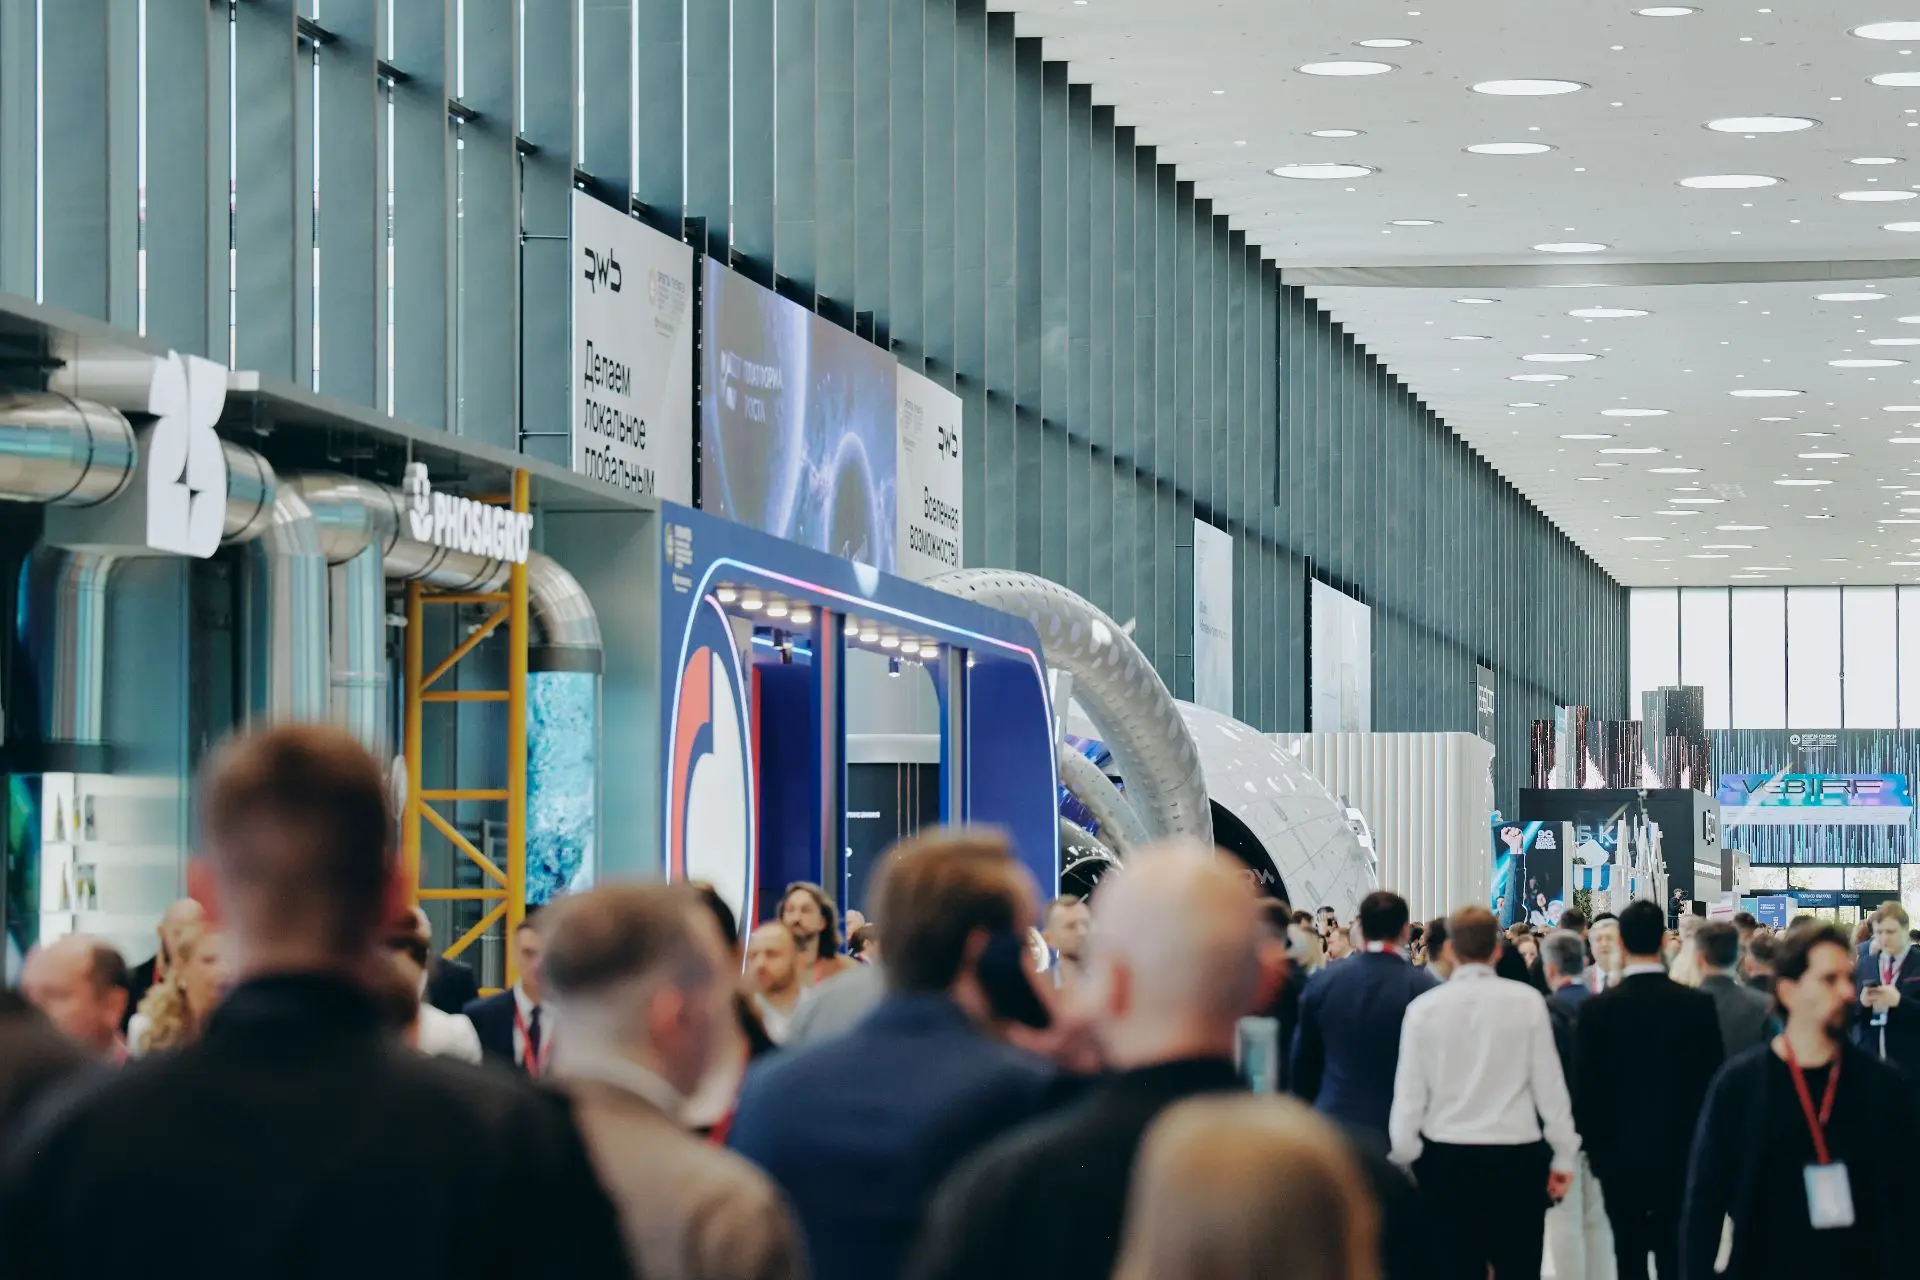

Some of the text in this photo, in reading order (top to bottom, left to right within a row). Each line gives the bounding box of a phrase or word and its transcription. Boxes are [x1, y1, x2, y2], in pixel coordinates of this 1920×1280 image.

[584, 339, 631, 397] Делаем
[584, 398, 647, 450] локальное
[584, 444, 656, 498] глобальным
[433, 491, 530, 565] PHOSAGRO
[924, 486, 959, 532] Вселенная
[909, 524, 959, 569] возможностей
